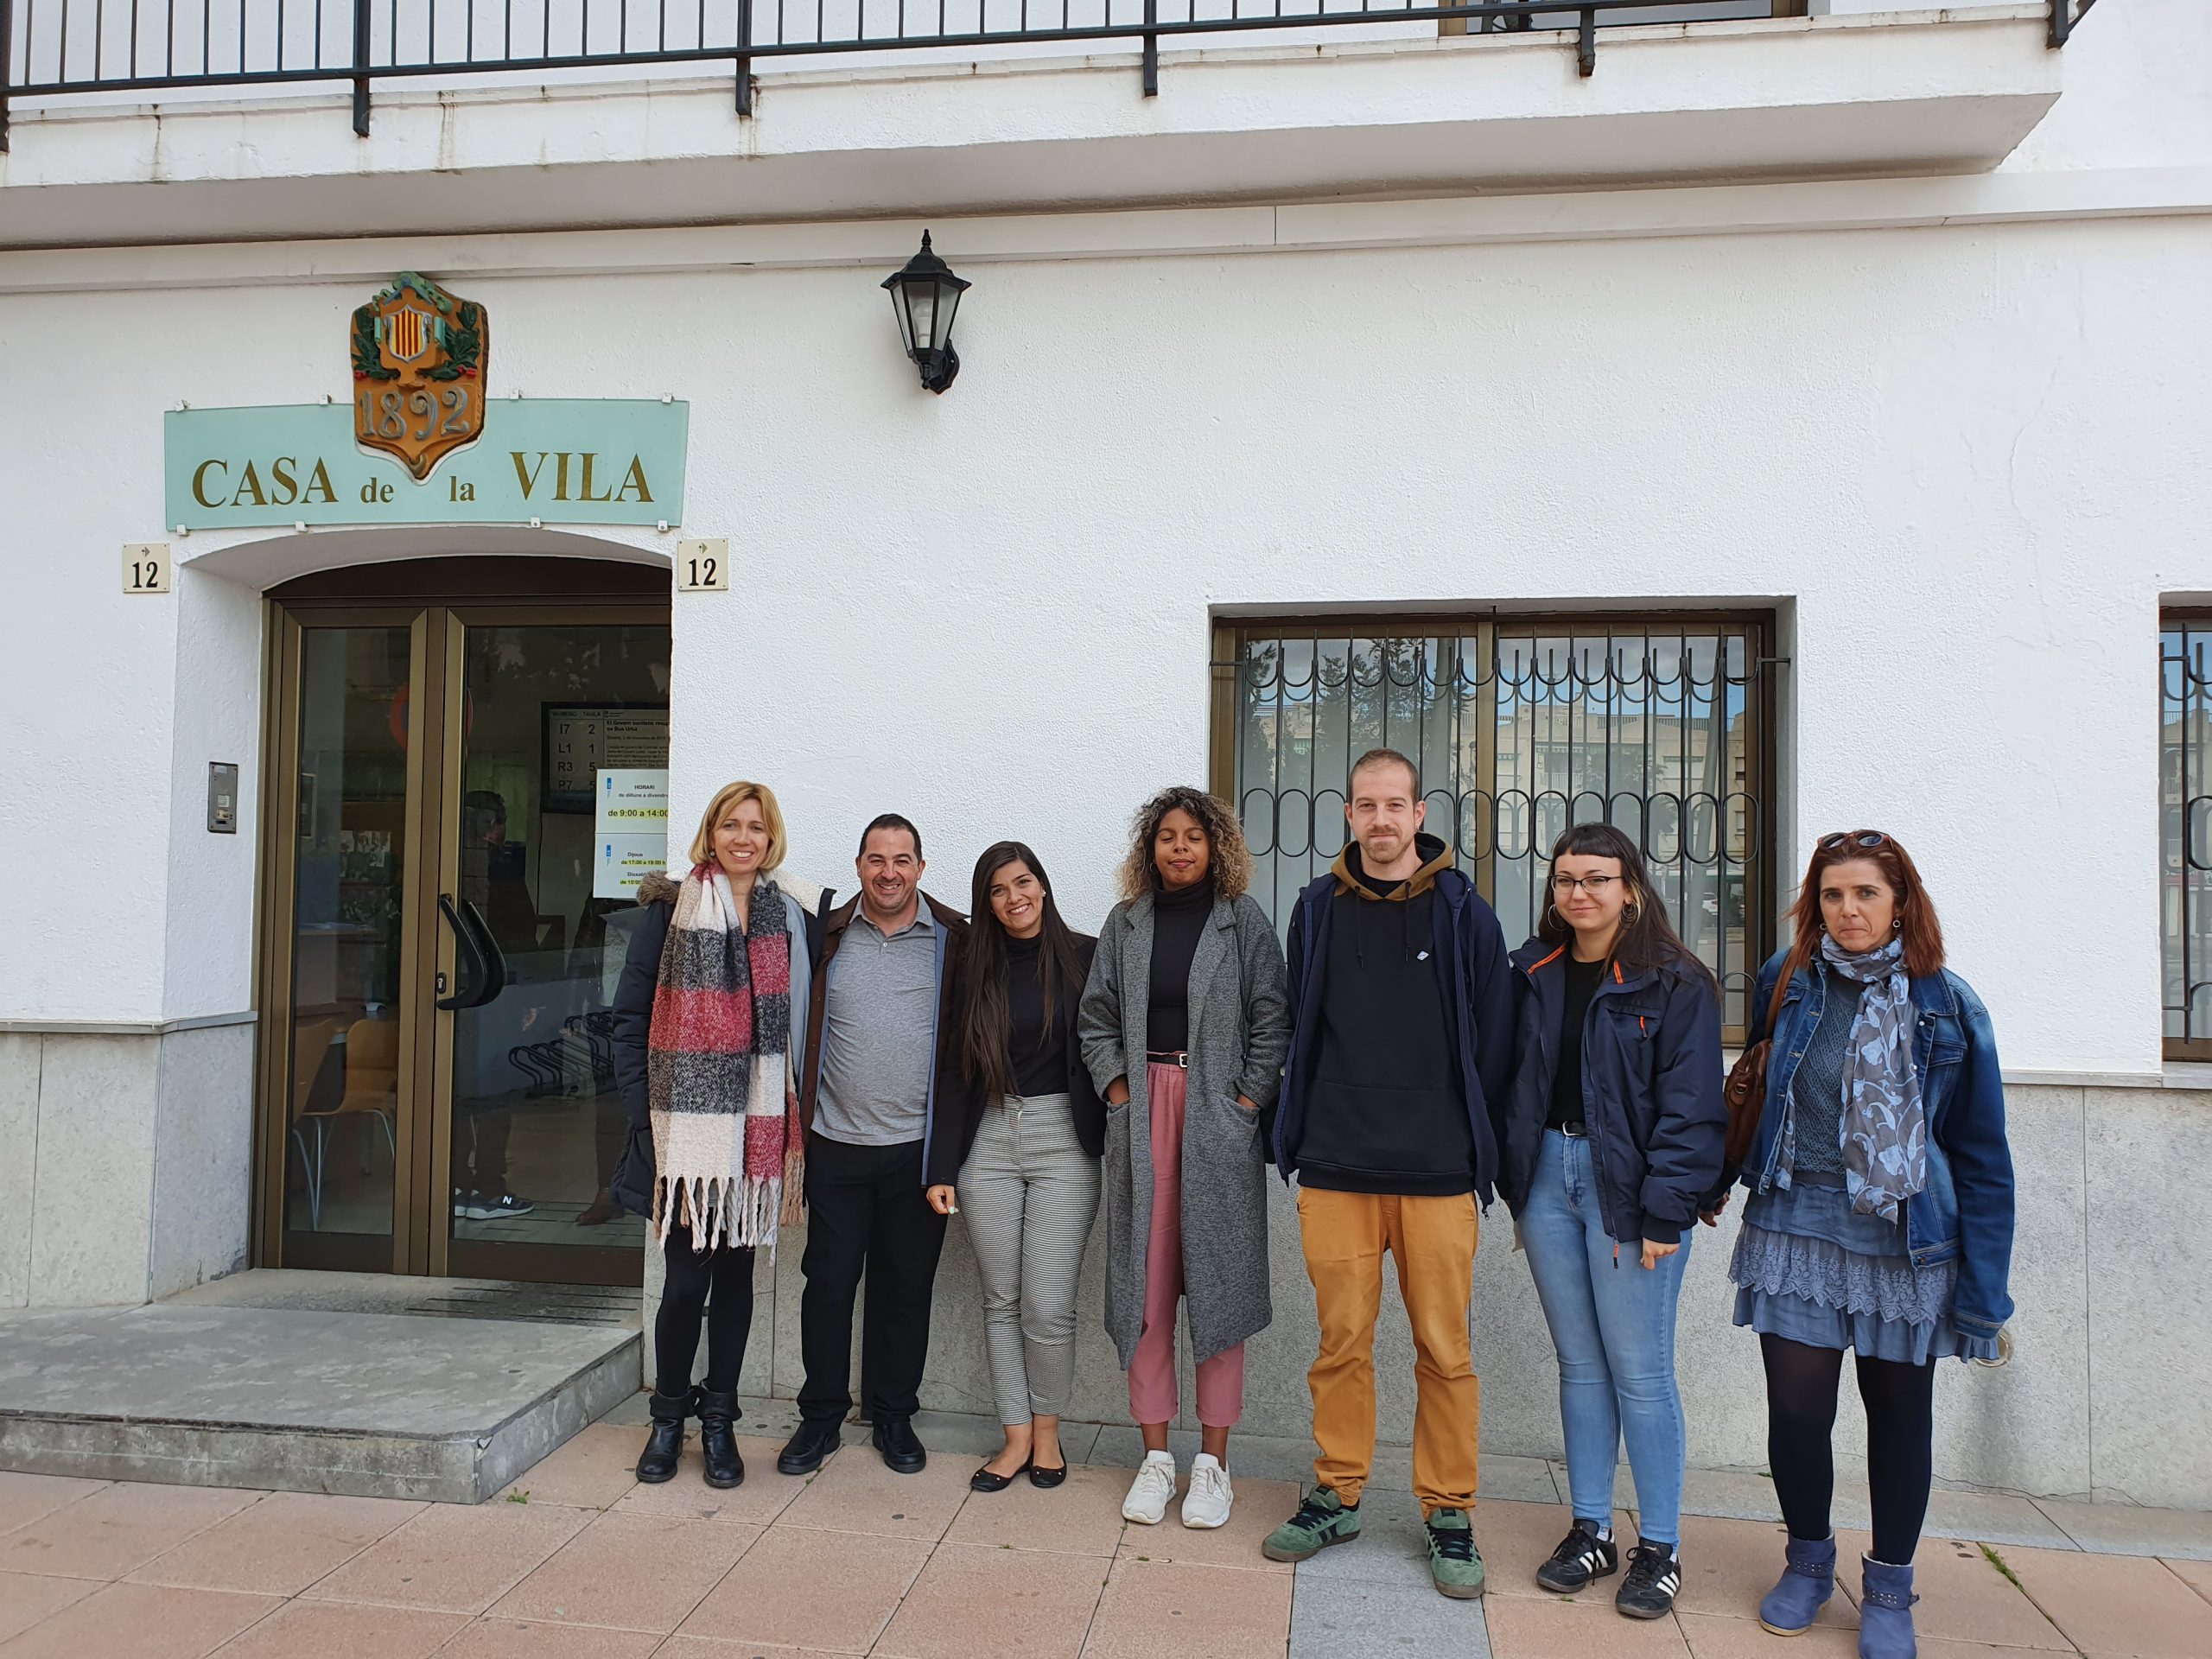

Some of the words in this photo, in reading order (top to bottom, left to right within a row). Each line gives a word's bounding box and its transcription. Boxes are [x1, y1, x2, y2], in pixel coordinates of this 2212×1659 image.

[359, 385, 470, 440] 1892
[192, 455, 339, 508] CASA
[359, 476, 394, 503] de
[448, 475, 475, 502] la
[509, 452, 655, 503] VILA
[131, 561, 158, 588] 12
[689, 557, 717, 587] 12
[588, 723, 595, 734] 2
[558, 743, 571, 753] L1
[588, 743, 594, 753] 1
[557, 762, 573, 772] R3
[588, 761, 595, 772] 5
[558, 780, 572, 790] P7
[588, 780, 595, 791] 5
[502, 1195, 512, 1205] N
